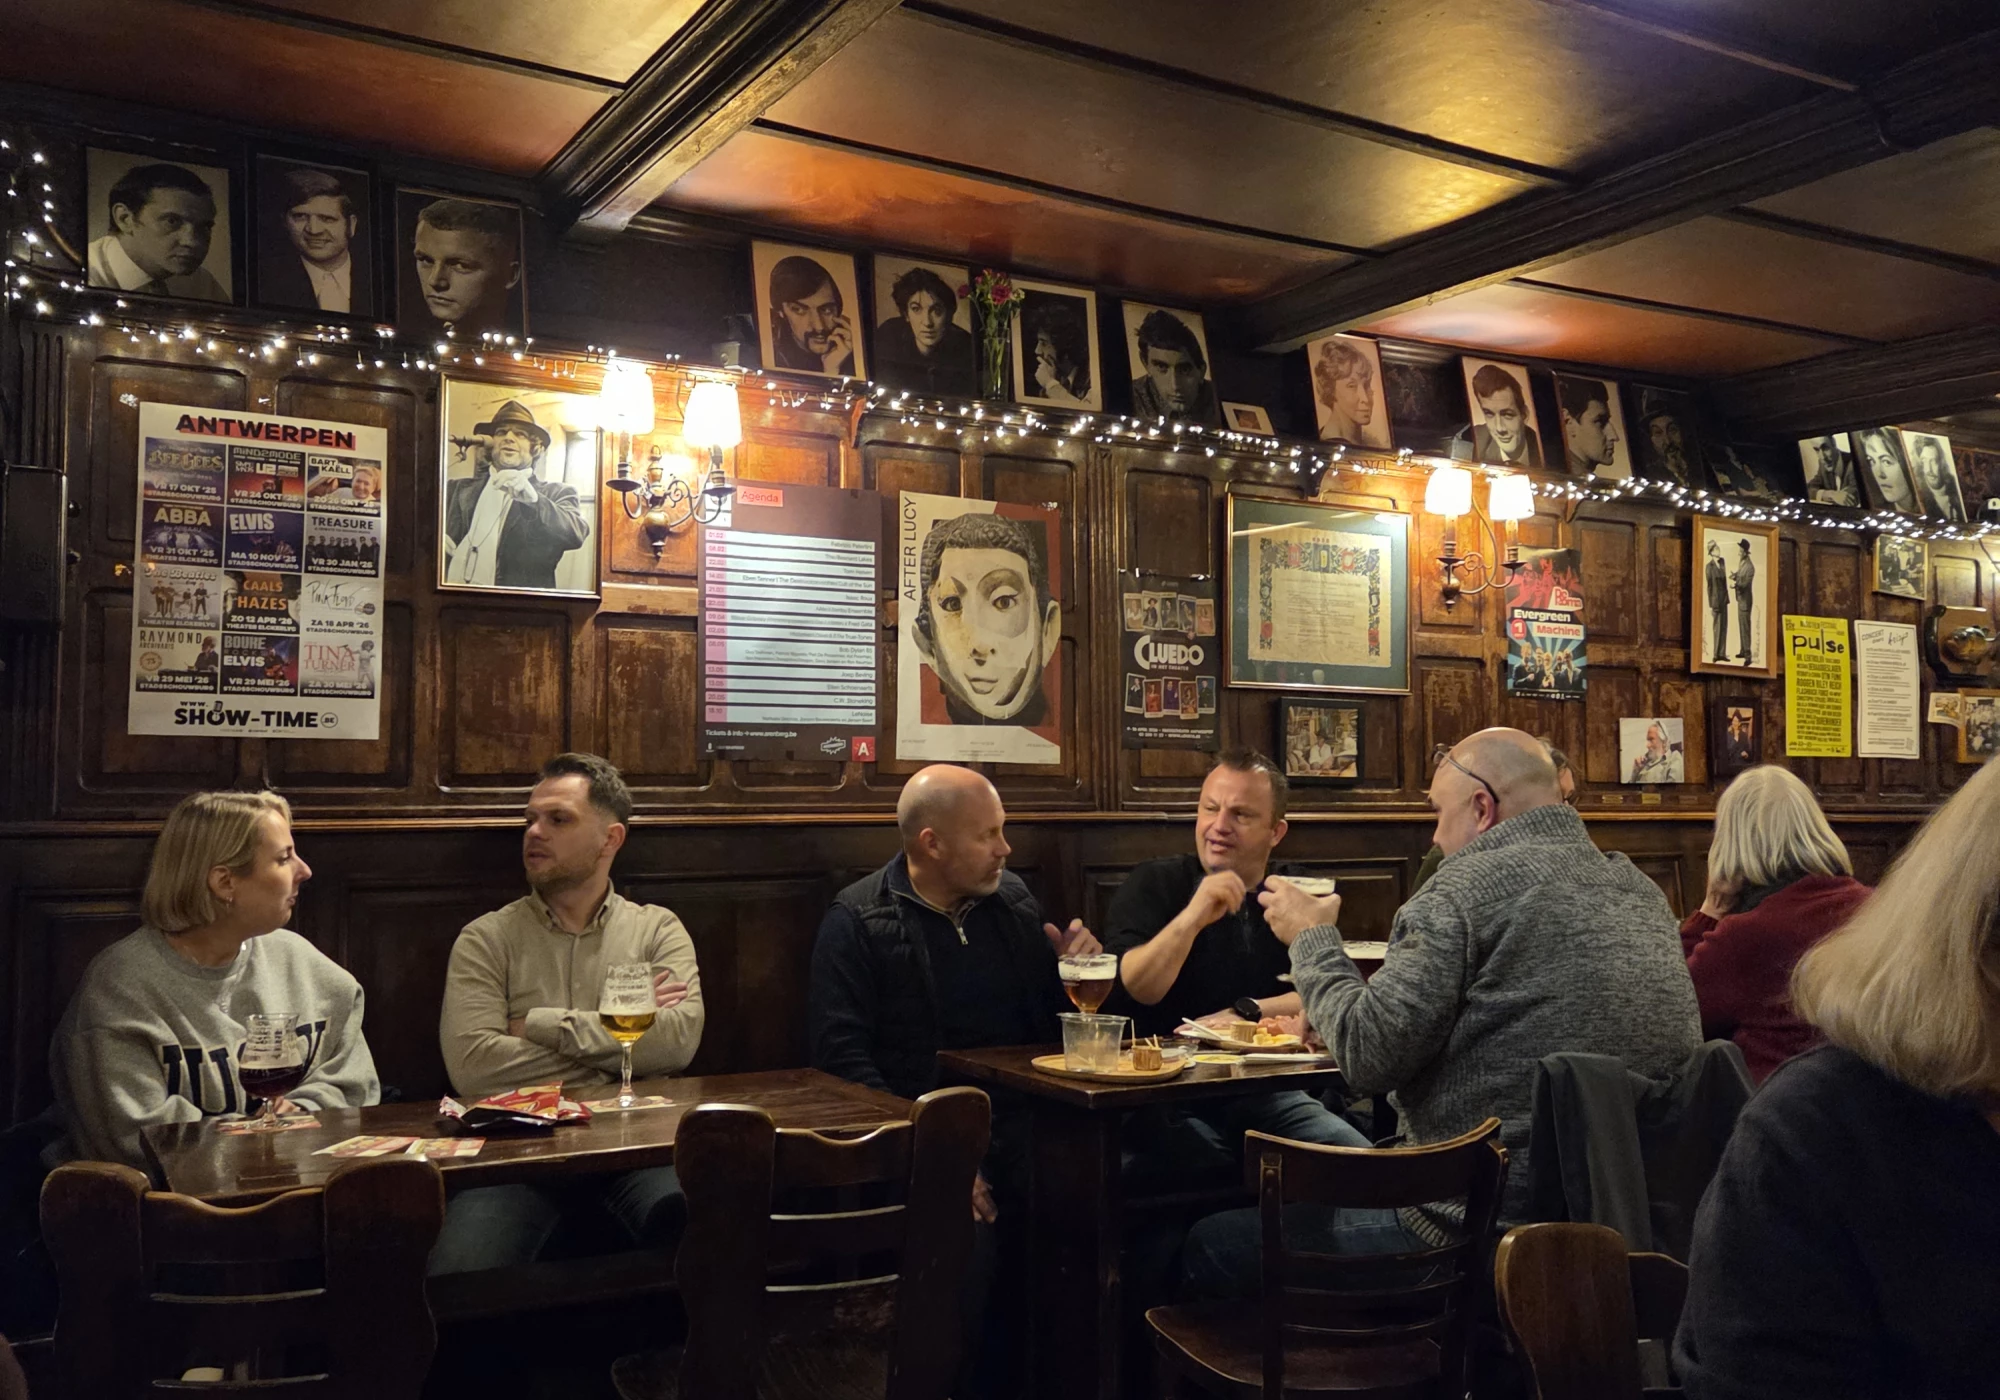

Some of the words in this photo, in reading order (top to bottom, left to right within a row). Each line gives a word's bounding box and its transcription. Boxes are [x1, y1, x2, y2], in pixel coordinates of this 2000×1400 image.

[176, 414, 353, 449] ANTWERPEN
[311, 458, 336, 466] BART
[153, 480, 166, 489] VR
[169, 483, 178, 491] 17
[180, 484, 200, 493] OKT
[234, 489, 248, 497] VR
[263, 492, 282, 500] OKT
[741, 490, 779, 503] Agenda
[230, 498, 302, 509] STADSSCHOUWBURG
[341, 498, 358, 506] OKT
[310, 504, 378, 514] STADSSCHOUWBURG
[154, 507, 212, 526] ABBA
[229, 513, 274, 530] ELVIS
[312, 516, 374, 530] TREASURE
[904, 496, 917, 541] LUCY
[177, 548, 198, 556] OKT
[231, 551, 246, 559] MA
[260, 554, 280, 562] NOV
[228, 560, 299, 569] STADSSCHOUWBURG
[308, 566, 376, 575] STADSSCHOUWBURG
[170, 568, 217, 581] Beatles
[904, 546, 917, 601] AFTER
[243, 580, 283, 592] CAALS
[237, 596, 287, 610] HAZES
[1514, 609, 1571, 622] Evergreen
[306, 627, 374, 635] STADSSCHOUWBURG
[1514, 622, 1523, 633] 1
[1537, 625, 1581, 636] Machine
[140, 630, 202, 644] RAYMOND
[304, 644, 355, 661] TINA
[1134, 634, 1204, 670] CLUEDO
[223, 655, 265, 667] ELVIS
[304, 660, 355, 672] TURNER
[174, 708, 318, 728] SHOW-TIME
[858, 742, 869, 756] A
